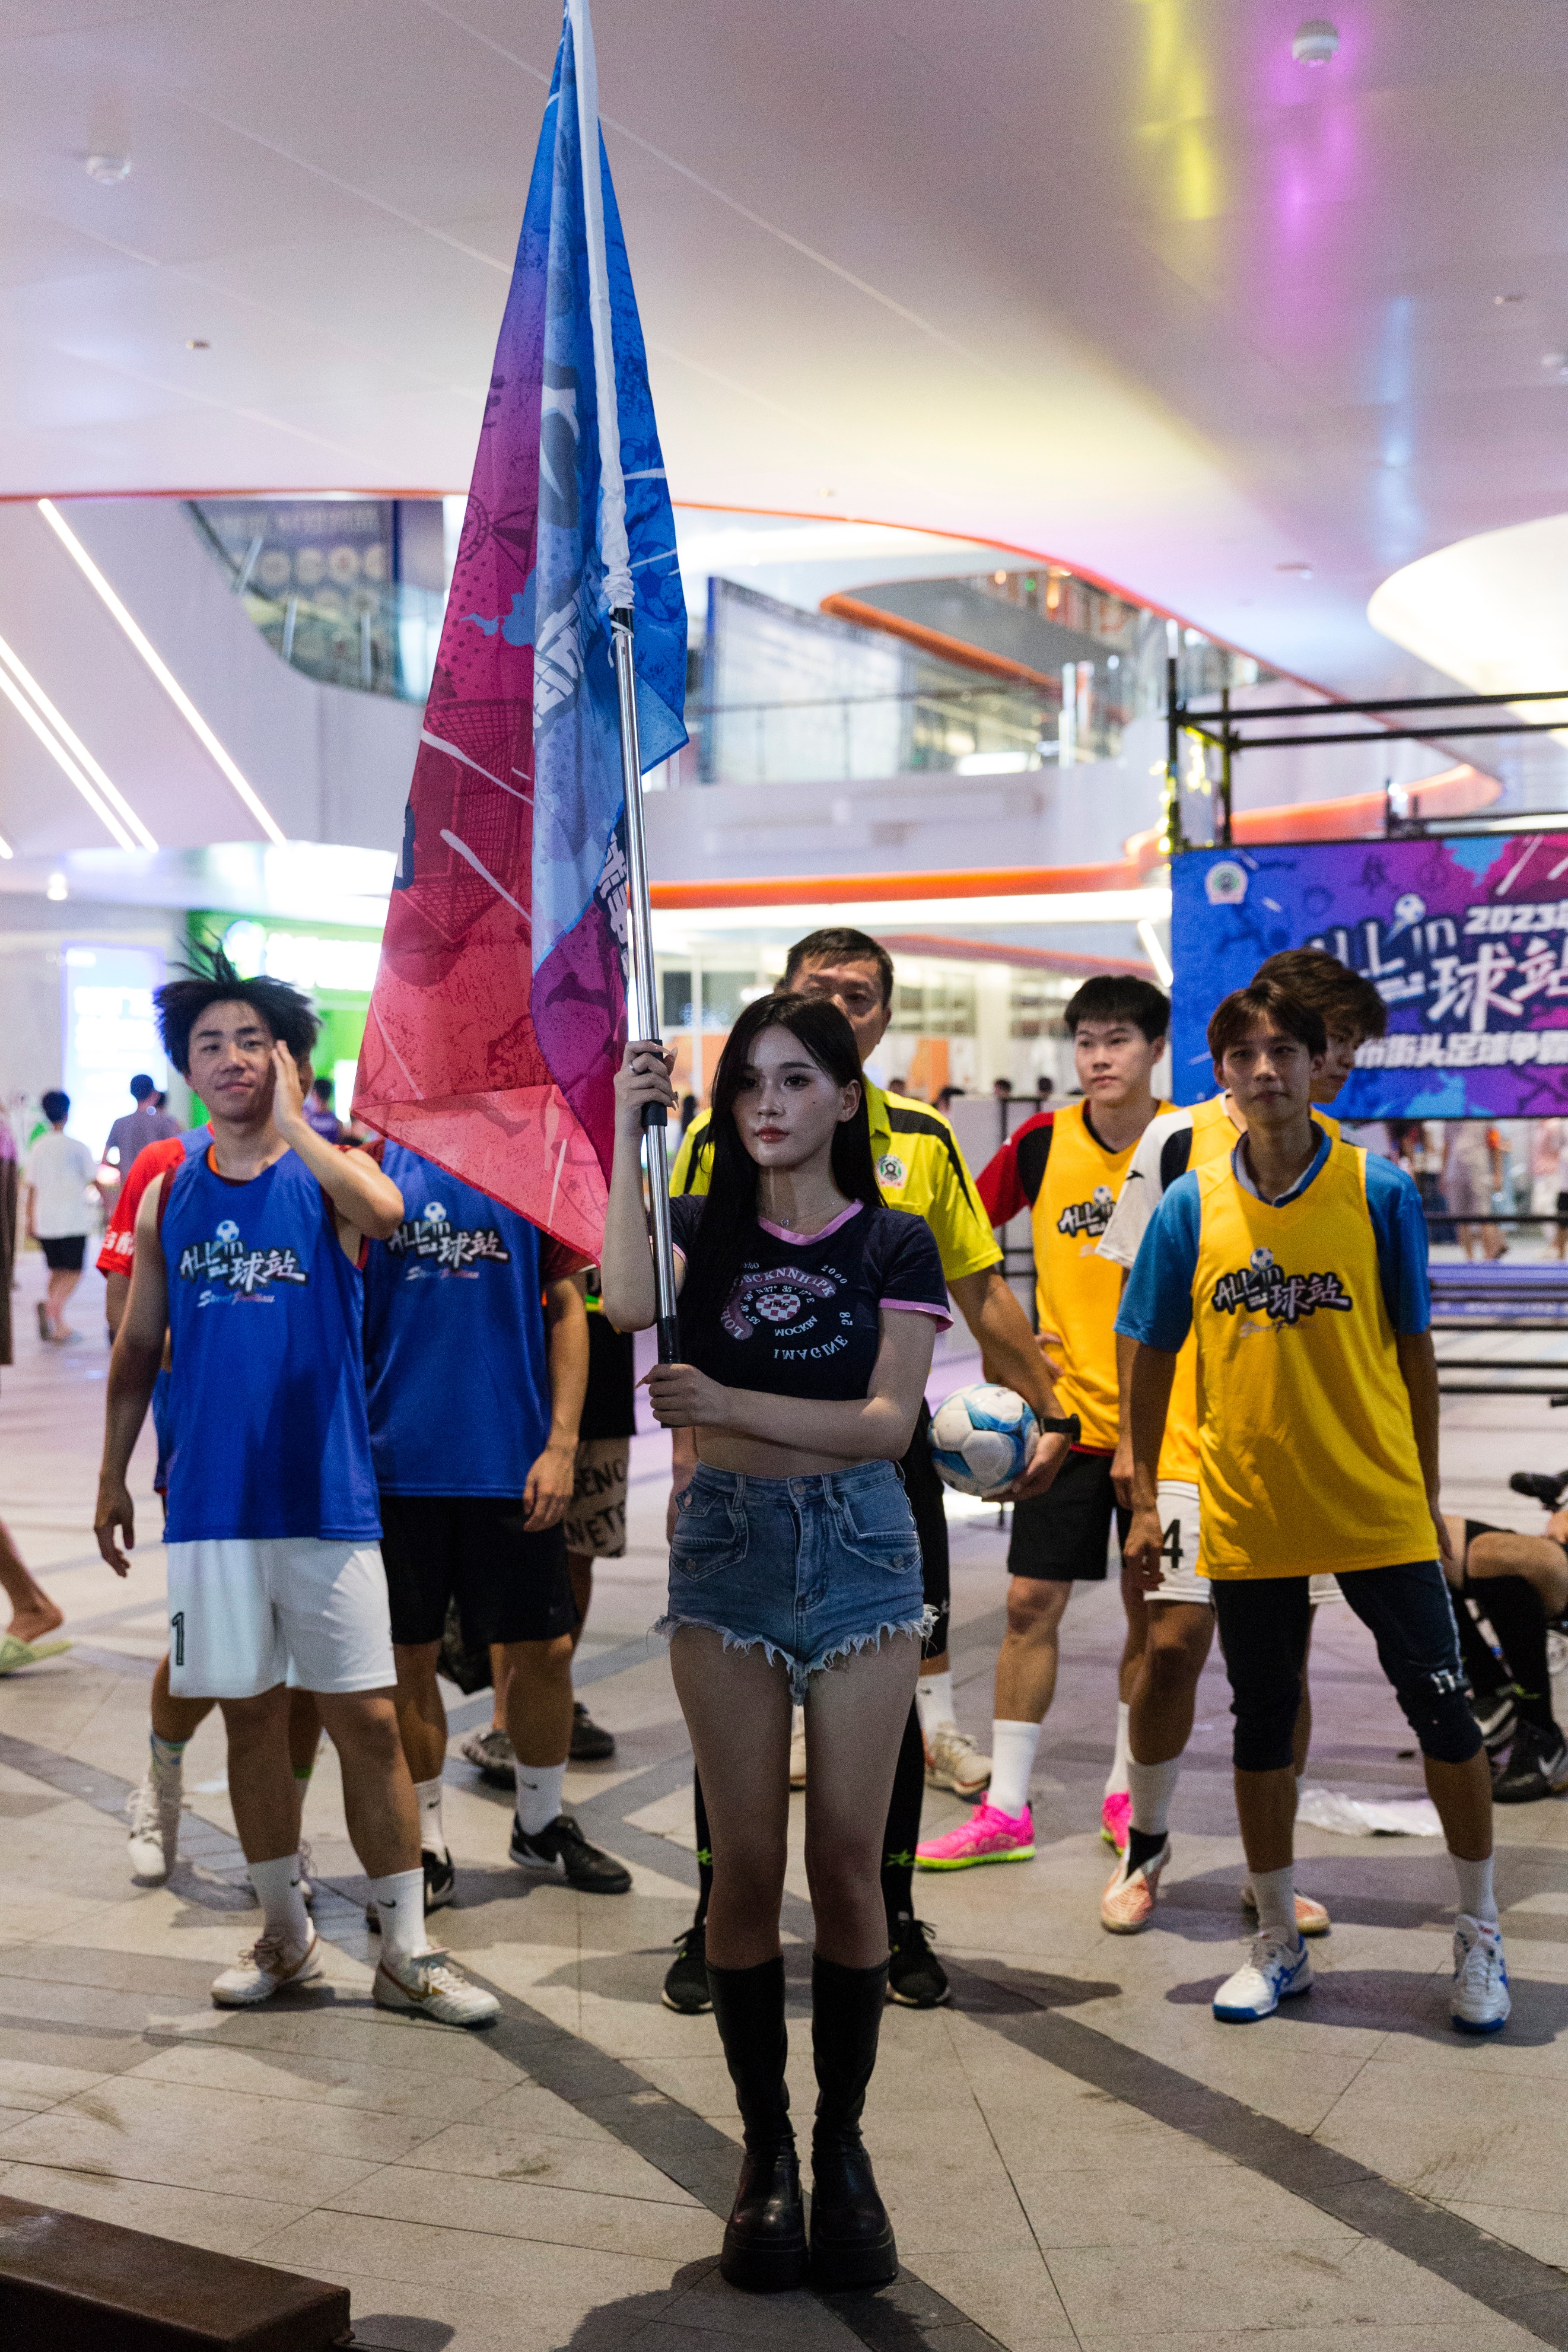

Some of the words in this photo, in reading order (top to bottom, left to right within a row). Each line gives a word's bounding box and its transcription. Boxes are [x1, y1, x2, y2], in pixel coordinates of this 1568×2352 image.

[437, 1230, 508, 1269] 球站
[228, 1250, 306, 1292] 球站
[821, 1264, 847, 1284] 2000
[1270, 1274, 1350, 1319] 球站
[171, 1611, 185, 1666] 1
